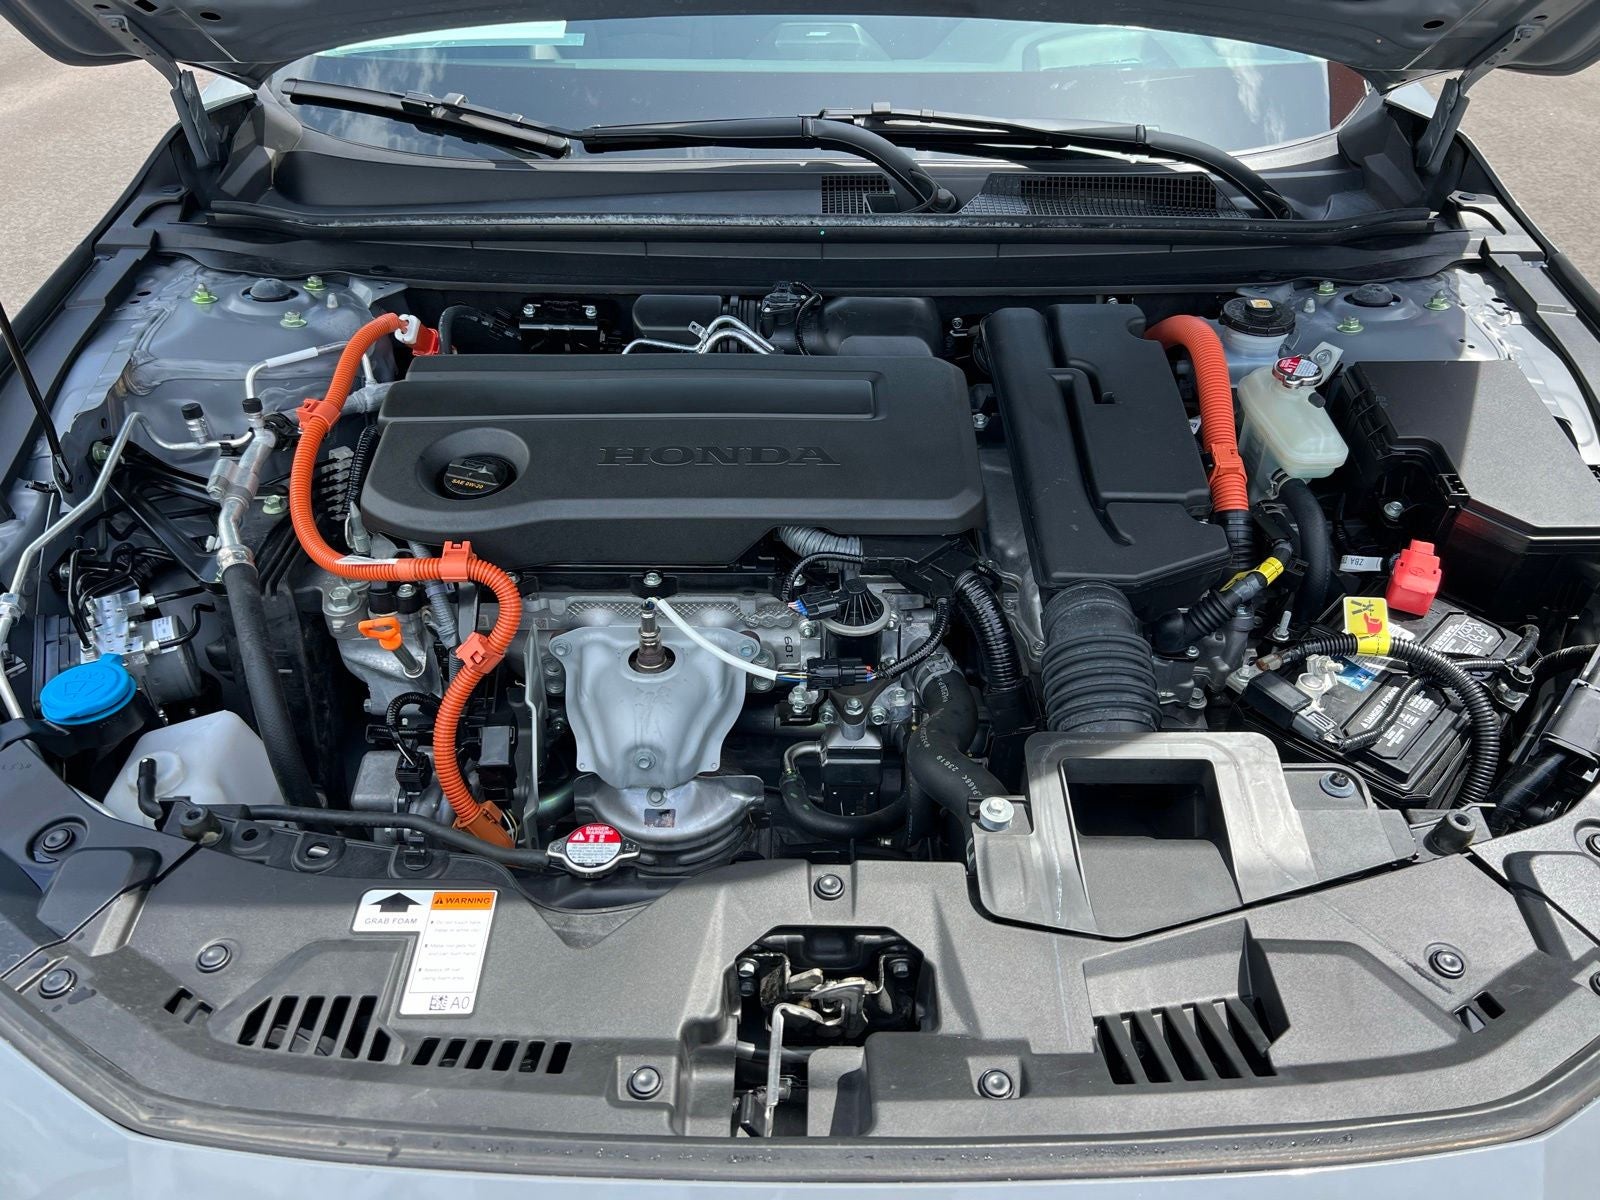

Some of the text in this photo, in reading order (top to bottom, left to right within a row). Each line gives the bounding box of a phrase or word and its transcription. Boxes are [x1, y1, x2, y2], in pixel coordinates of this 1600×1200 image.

[597, 446, 840, 466] HONDA
[784, 636, 794, 658] 109
[446, 897, 491, 905] WARNING
[365, 917, 419, 925] GRAB FOAM
[450, 996, 470, 1009] A0
